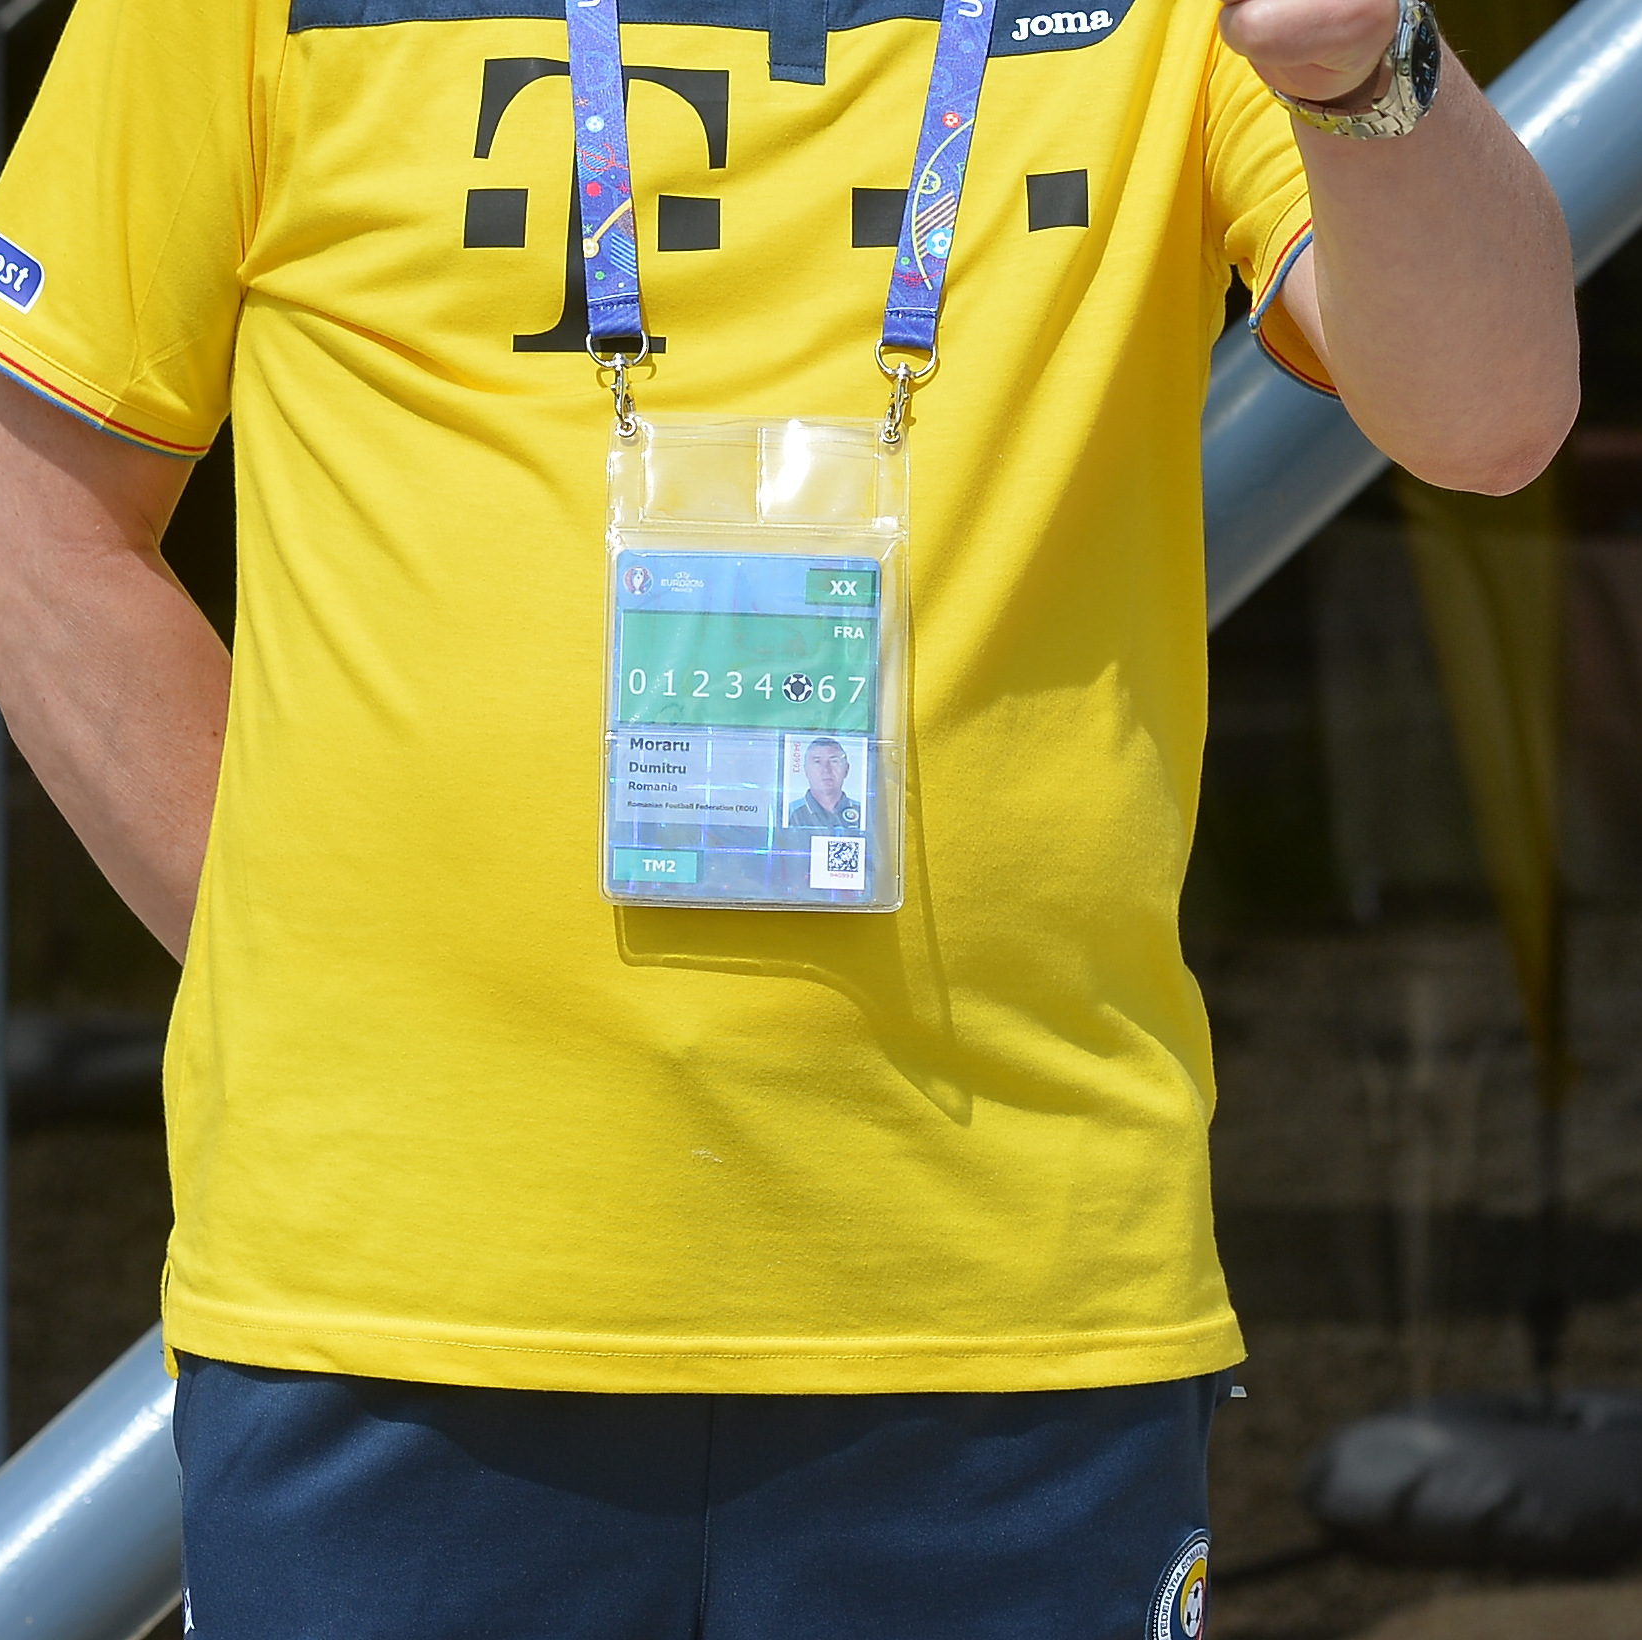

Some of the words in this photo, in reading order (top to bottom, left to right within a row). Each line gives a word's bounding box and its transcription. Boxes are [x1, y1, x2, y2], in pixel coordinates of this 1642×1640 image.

[829, 579, 857, 596] XX
[834, 626, 865, 639] FRA
[628, 668, 647, 695] 0
[663, 669, 677, 696] 1
[692, 670, 710, 697] 2
[725, 671, 743, 699] 3
[754, 673, 773, 700] 4
[818, 675, 836, 702] 6
[847, 676, 866, 703] 7
[629, 737, 690, 752] Moraru
[628, 761, 687, 775] Dumitru
[628, 781, 678, 792] Romania
[642, 859, 676, 873] TM2
